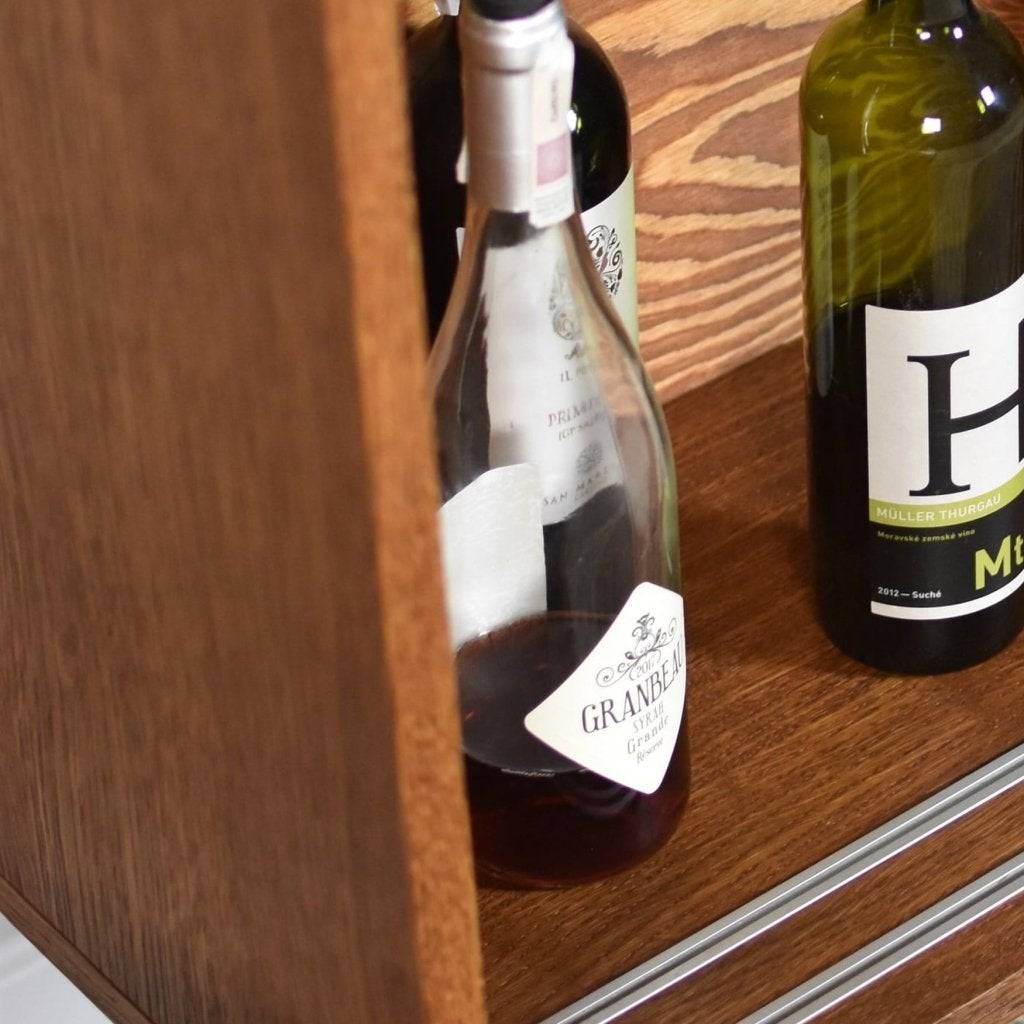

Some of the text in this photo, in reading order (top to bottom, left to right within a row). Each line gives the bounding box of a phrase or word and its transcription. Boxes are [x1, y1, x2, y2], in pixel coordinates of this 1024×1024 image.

[876, 493, 1001, 522] MÜLLER THURGAU
[975, 533, 1024, 591] Mt
[877, 586, 900, 597] 2012
[911, 589, 942, 599] Suché
